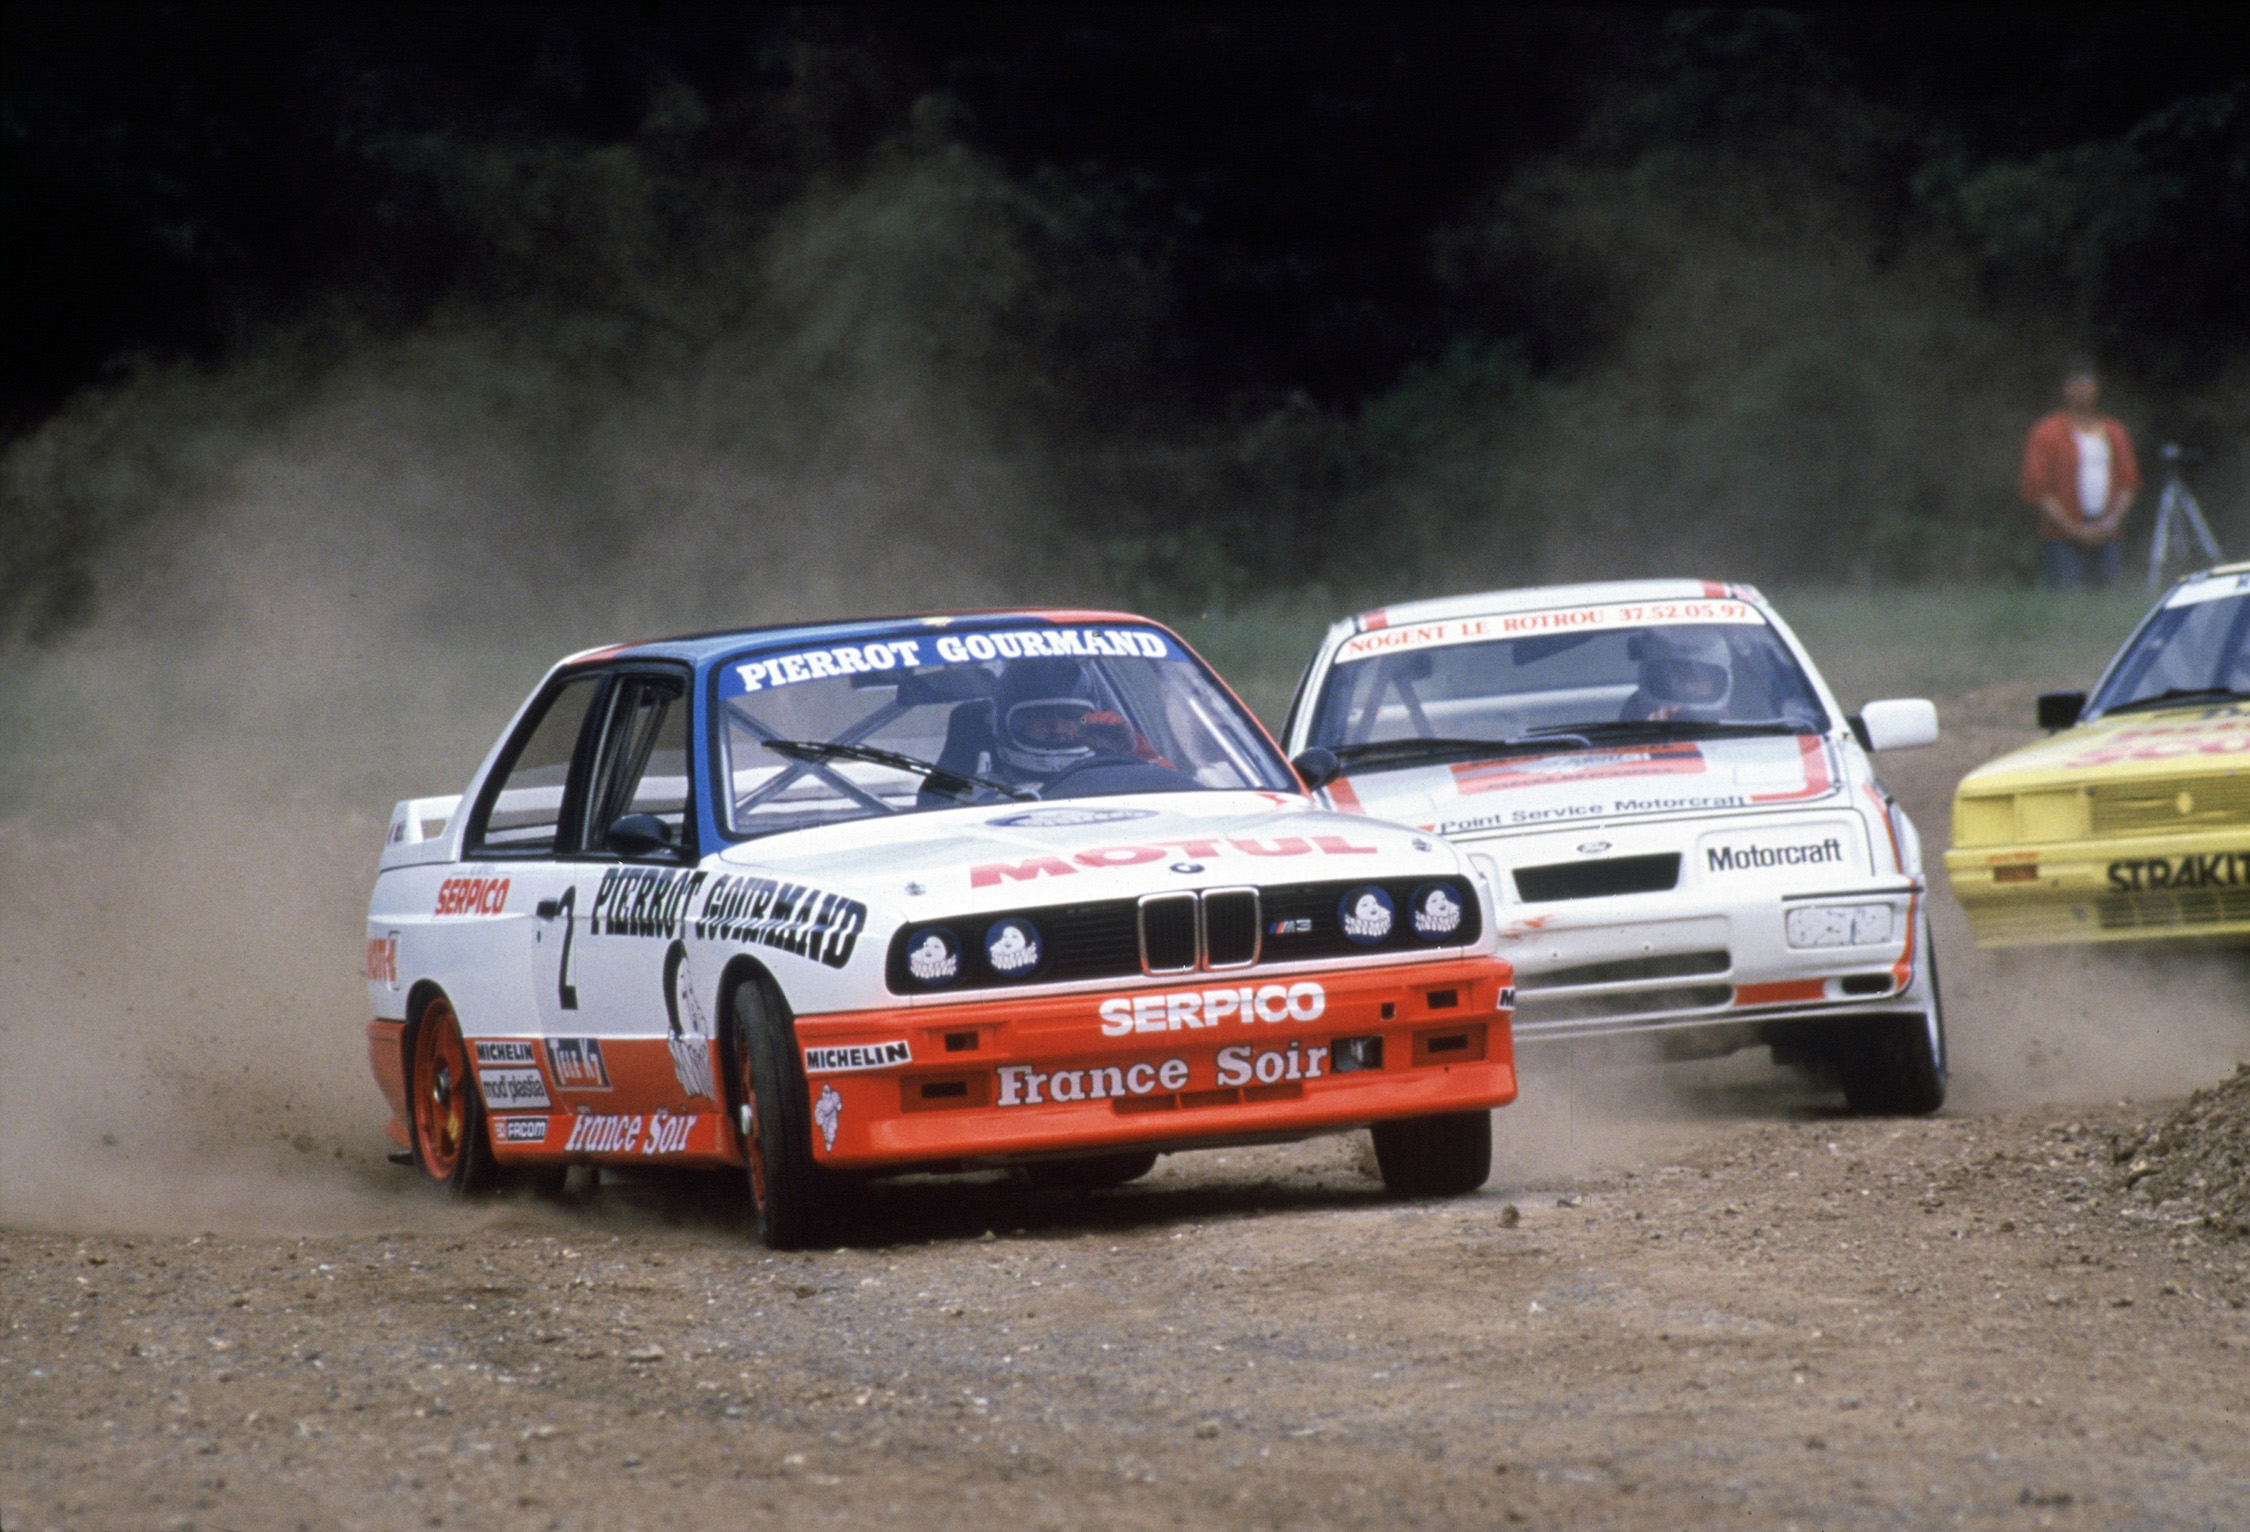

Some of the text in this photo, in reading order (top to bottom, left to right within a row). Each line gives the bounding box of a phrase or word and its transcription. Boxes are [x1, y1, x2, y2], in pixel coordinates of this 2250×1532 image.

[1349, 602, 1748, 656] NOGENT LE ROTROU 37.52.05.97
[736, 630, 1168, 692] PIERROT GOURMAND
[1439, 793, 1746, 833] Point Service Motorcraft
[971, 836, 1378, 888] MOTUL
[1707, 838, 1842, 872] Motorcraft
[434, 877, 512, 916] SERPICO
[591, 866, 867, 969] PIERROT GOURMAND
[1099, 981, 1326, 1037] SERPICO
[476, 1043, 534, 1061] MICHELIN
[806, 1042, 909, 1069] MICHELIN
[996, 1041, 1327, 1106] France Soir
[507, 1121, 546, 1139] FACOM
[564, 1104, 698, 1155] France Soir
